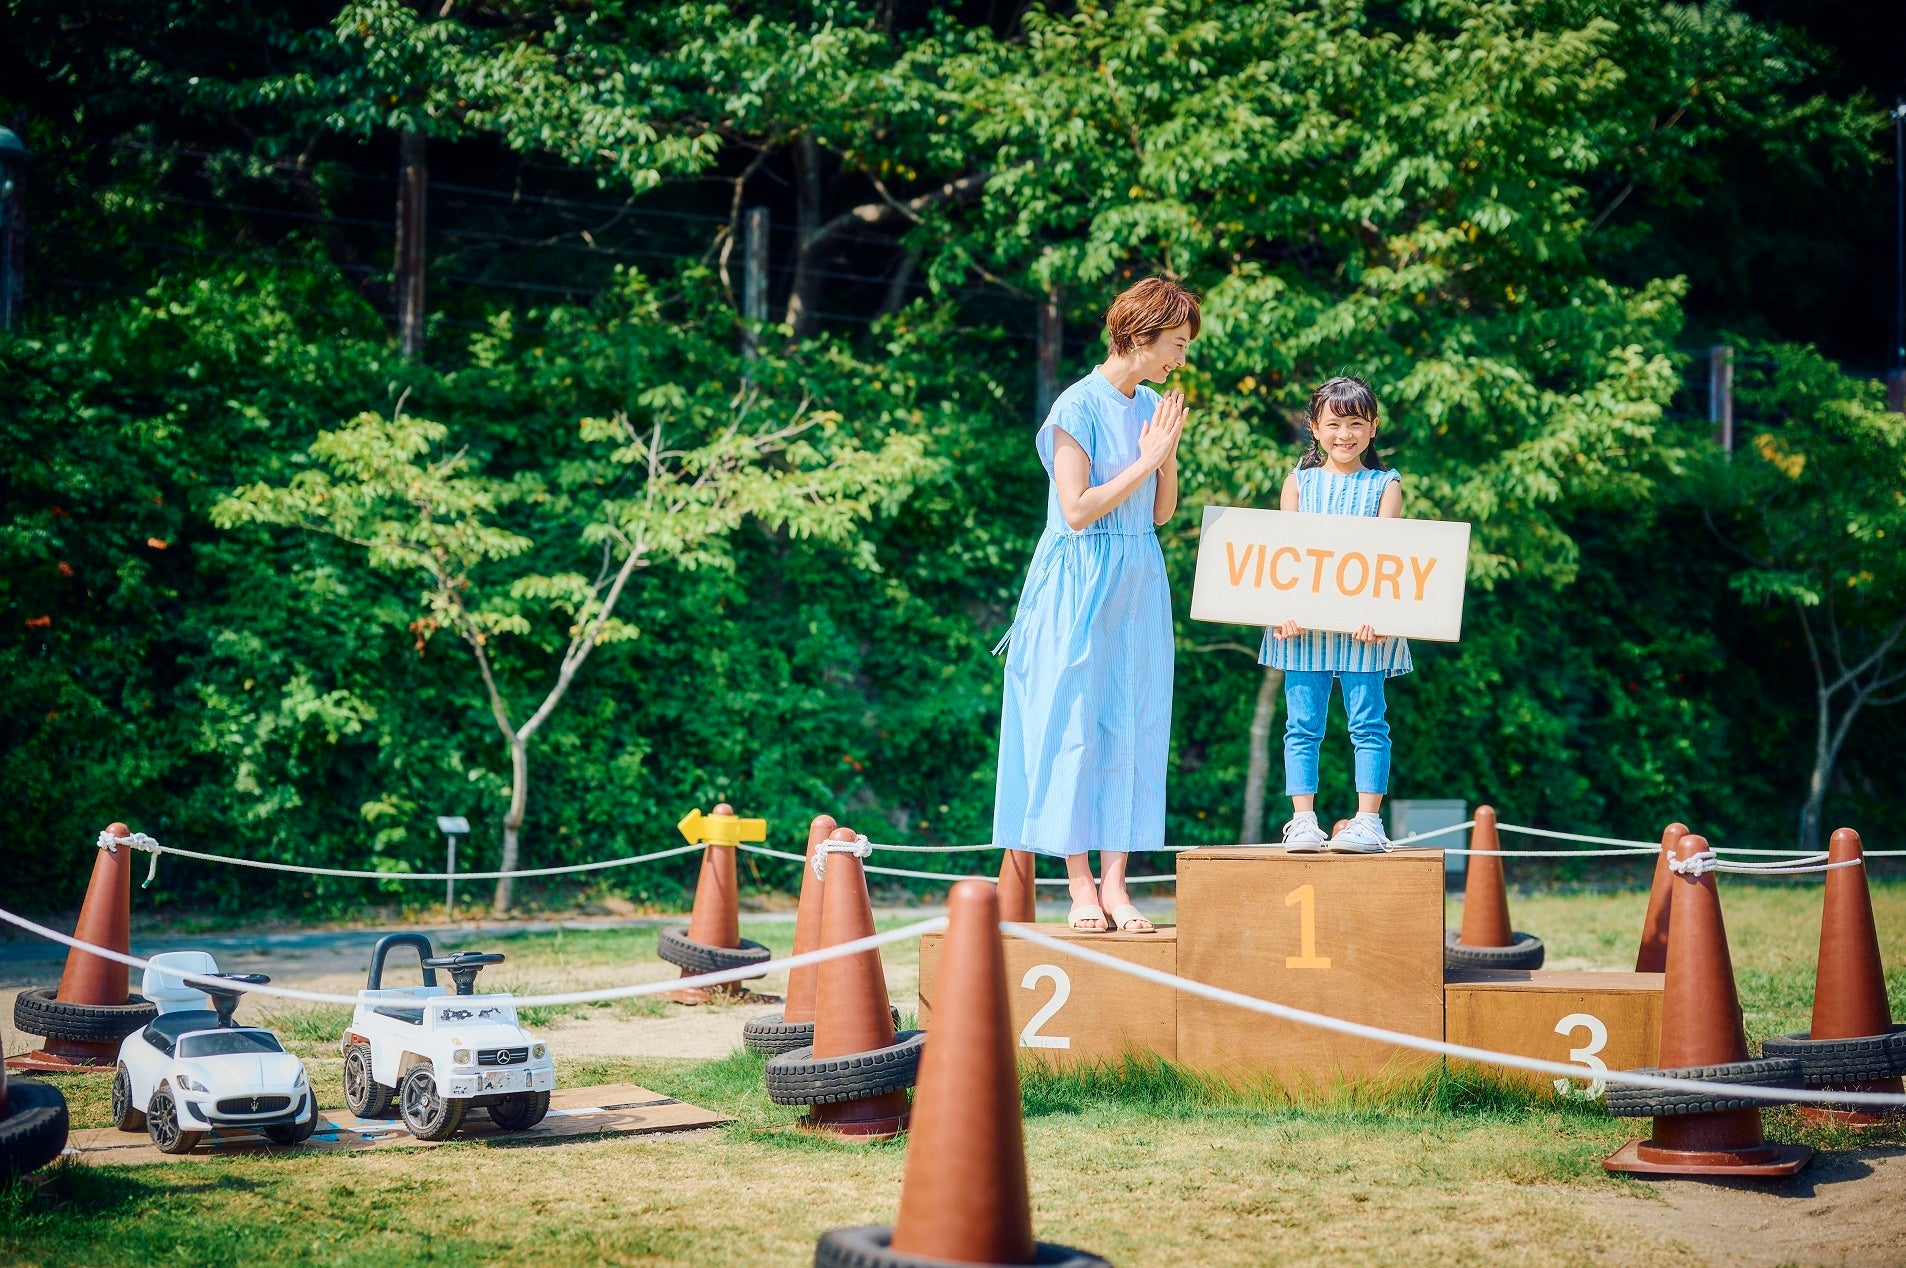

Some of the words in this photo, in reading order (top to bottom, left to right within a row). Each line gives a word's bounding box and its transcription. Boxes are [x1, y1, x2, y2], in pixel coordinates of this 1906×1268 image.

[1225, 541, 1438, 601] VICTORY
[1284, 884, 1333, 970] 1
[1018, 963, 1072, 1050] 2
[1552, 1013, 1608, 1101] 3
